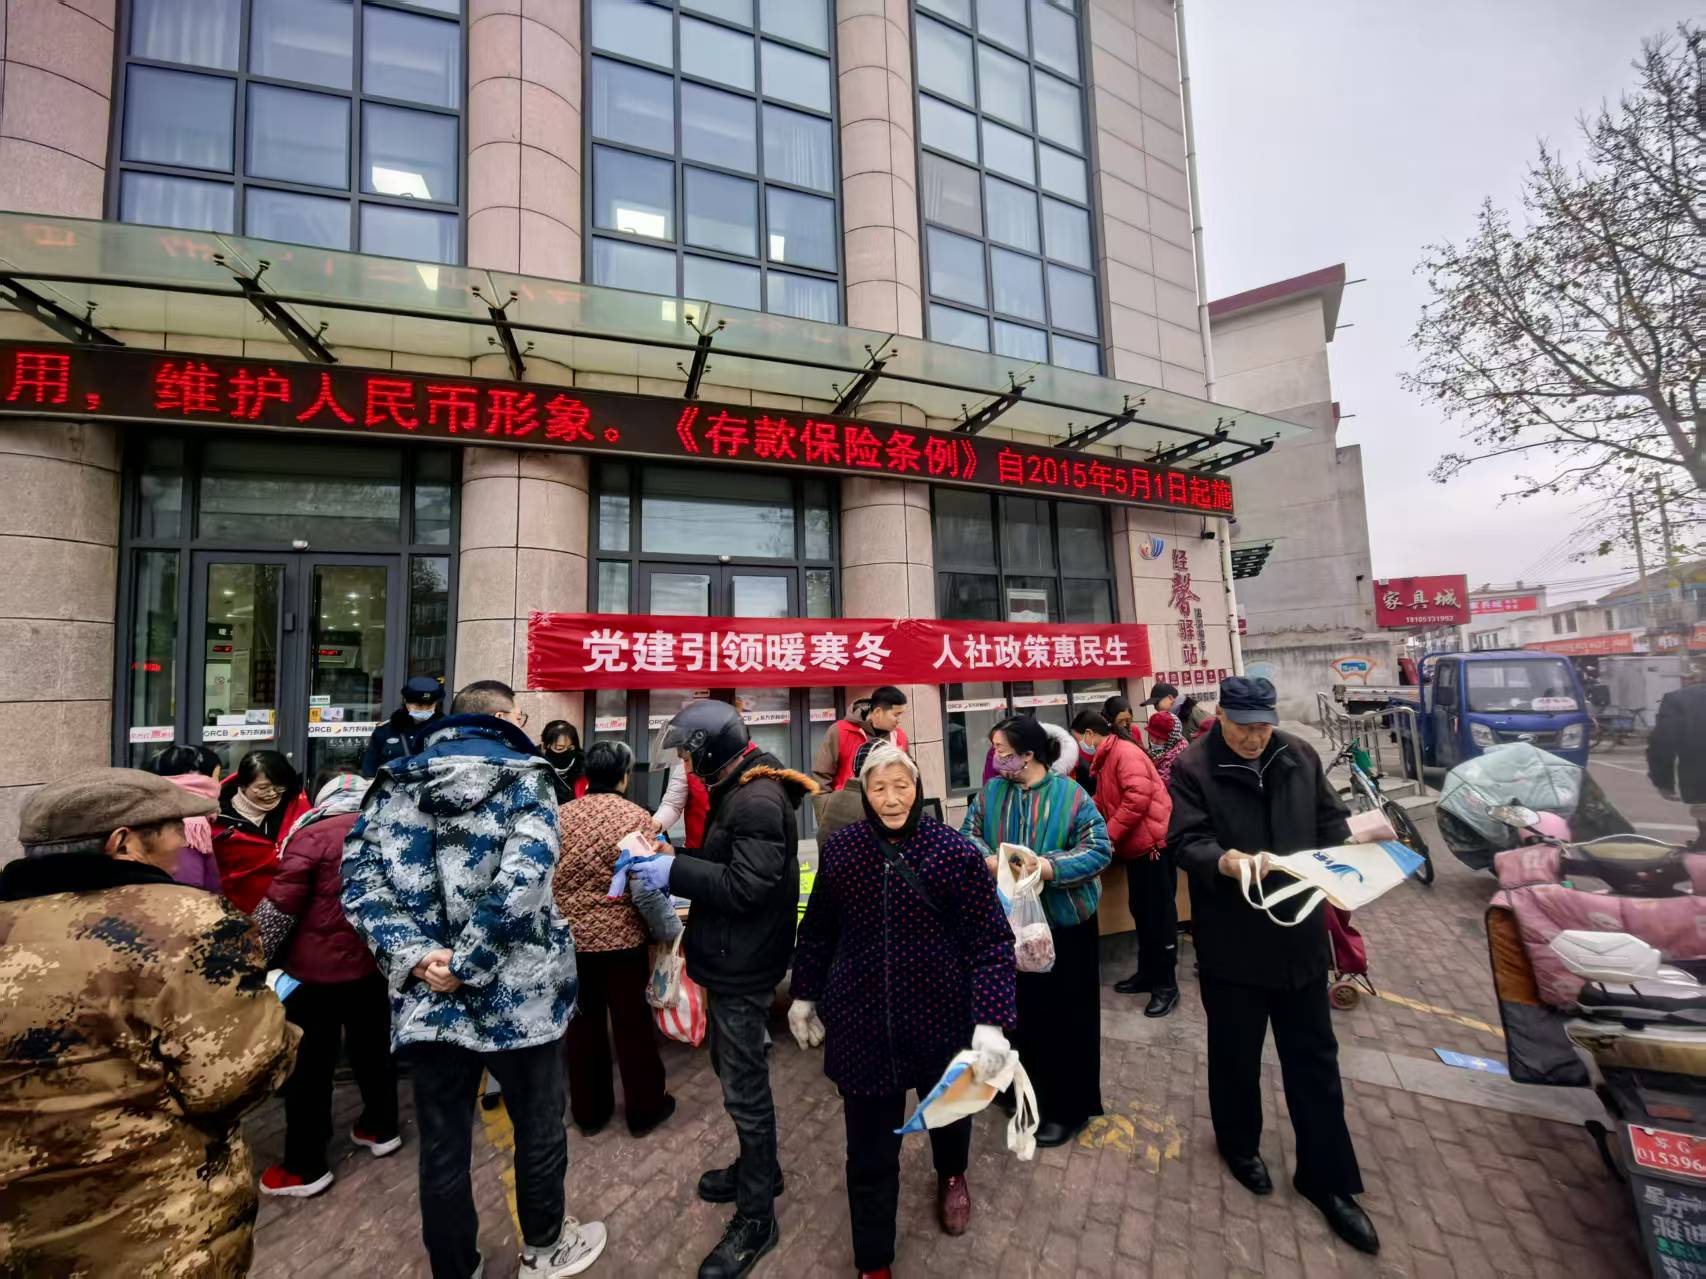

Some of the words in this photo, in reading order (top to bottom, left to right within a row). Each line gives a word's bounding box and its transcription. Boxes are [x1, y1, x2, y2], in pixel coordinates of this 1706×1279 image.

[1383, 588, 1461, 610] 家具城
[582, 628, 892, 672] 党建引领暖寒冬
[933, 633, 1131, 669] 人社政策惠民生
